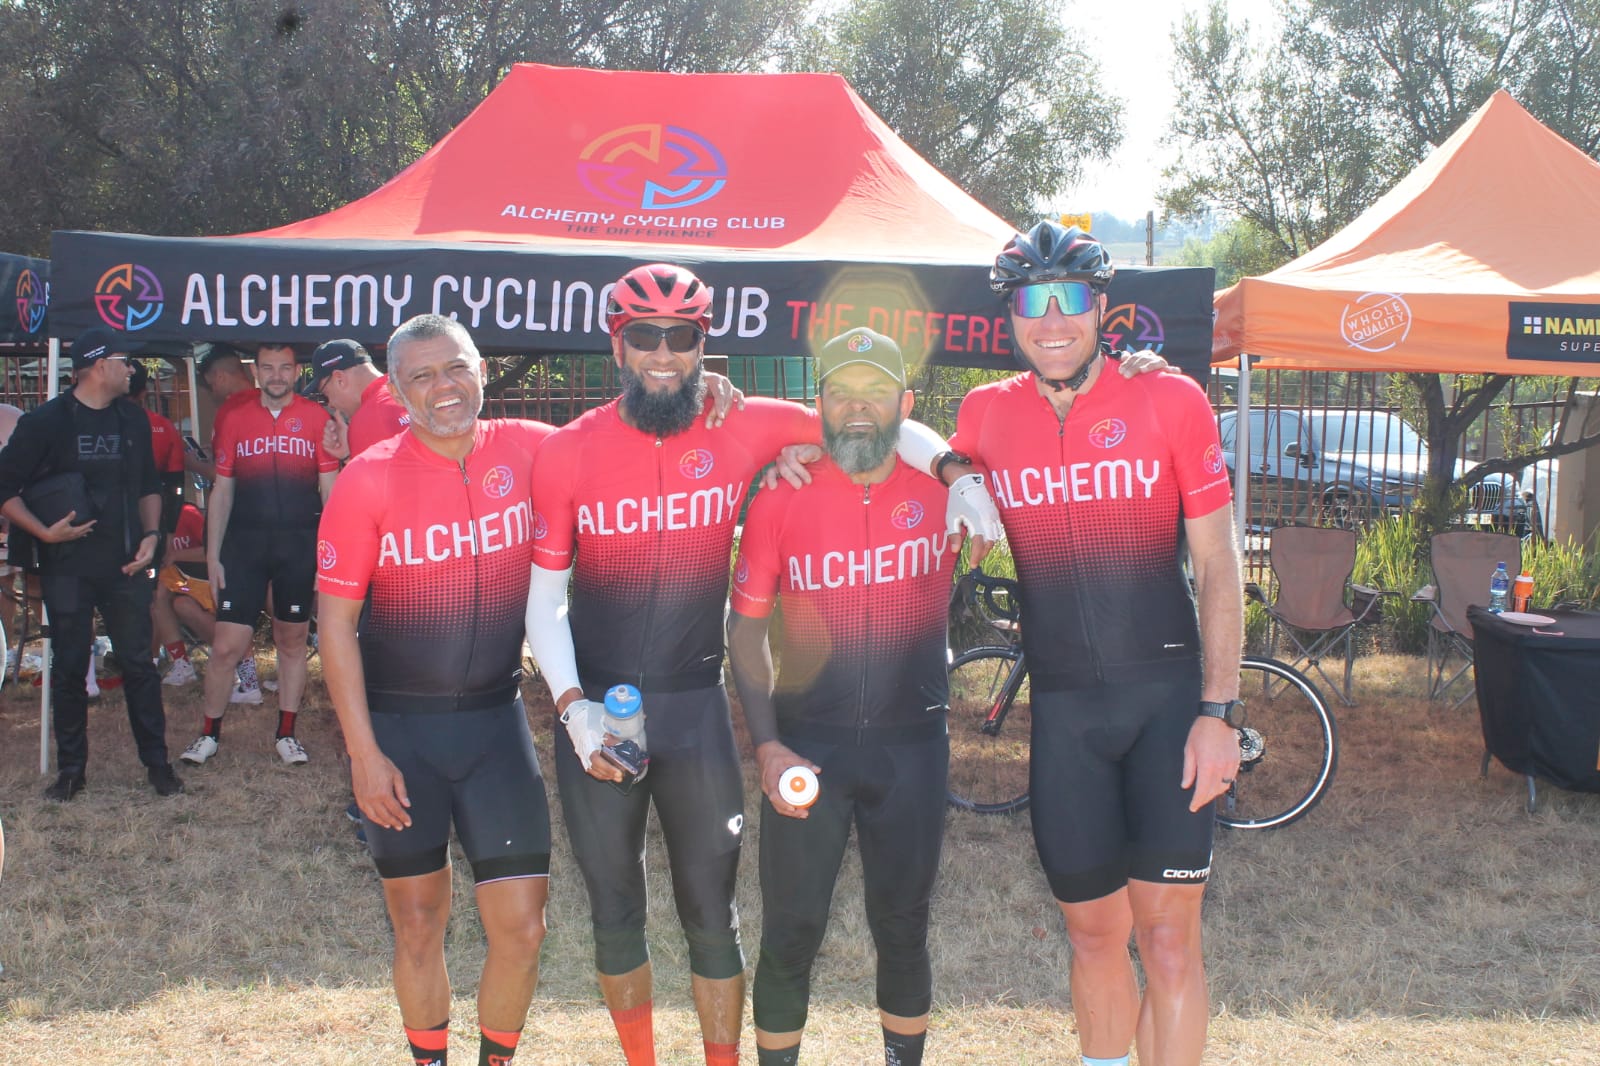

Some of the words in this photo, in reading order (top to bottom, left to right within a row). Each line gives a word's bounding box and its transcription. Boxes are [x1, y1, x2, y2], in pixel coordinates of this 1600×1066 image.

[501, 204, 615, 225] ALCHEMY
[623, 214, 718, 229] CYCLING
[726, 216, 785, 229] CLUB
[566, 223, 599, 234] THE
[606, 226, 715, 238] DIFFERENCE
[181, 273, 413, 327] ALCHEMY
[1347, 301, 1401, 331] WHOLE
[1352, 311, 1404, 341] QUALITY
[236, 435, 316, 459] ALCHEMY
[990, 458, 1161, 509] ALCHEMY
[577, 481, 744, 535] ALCHEMY
[788, 530, 949, 591] ALCHEMY
